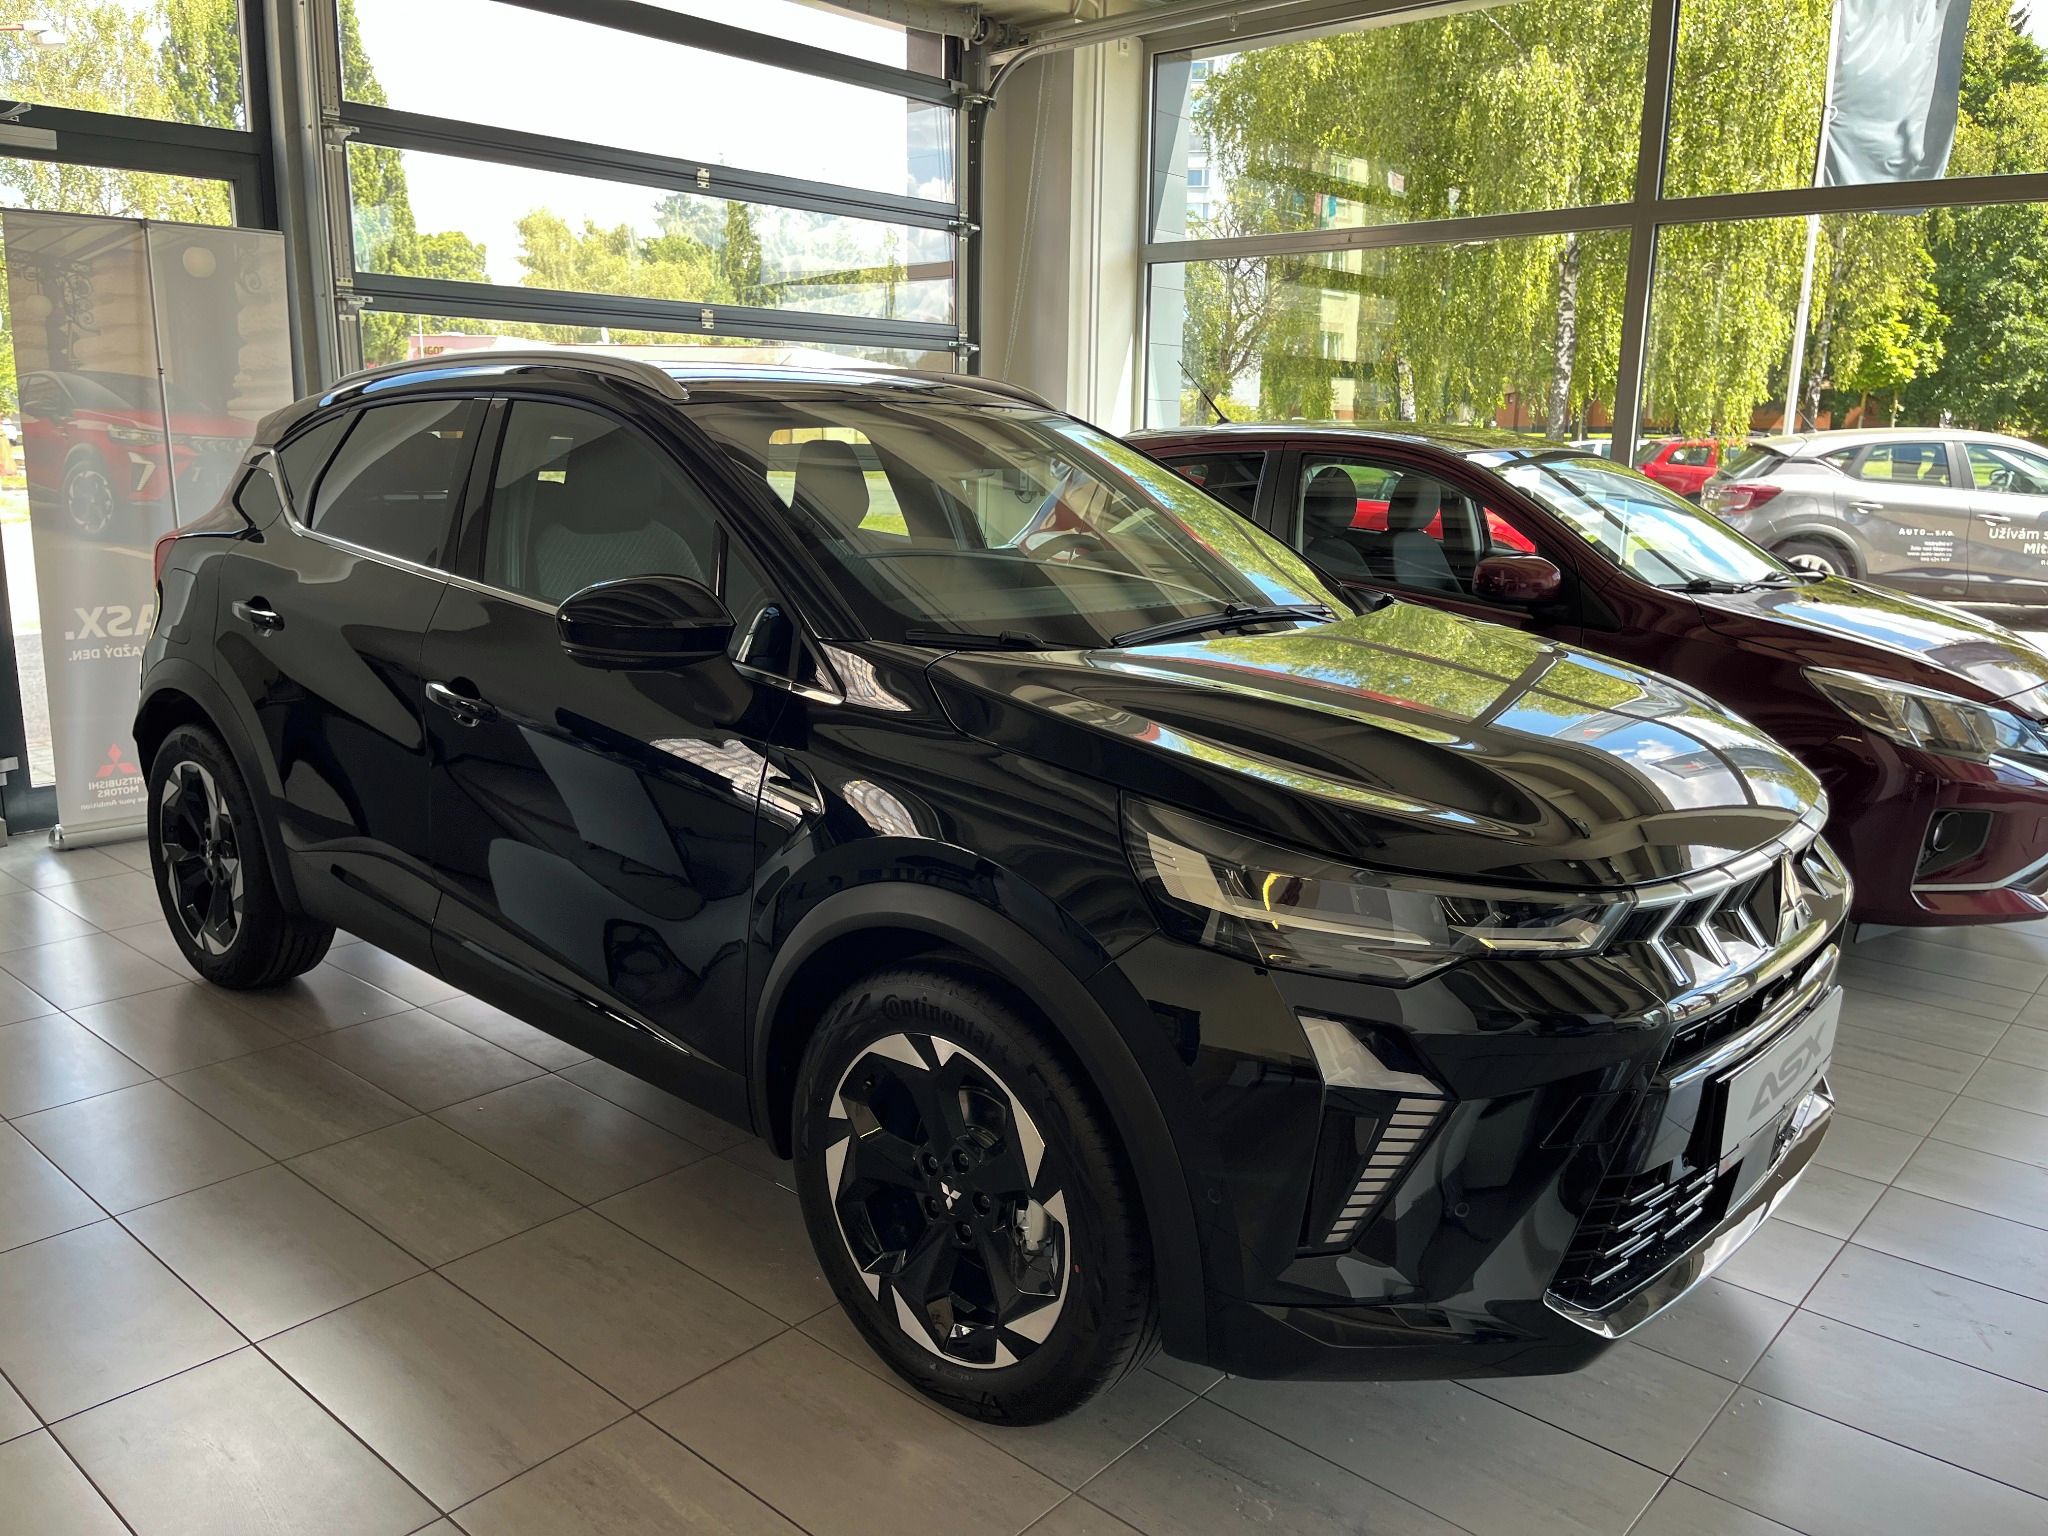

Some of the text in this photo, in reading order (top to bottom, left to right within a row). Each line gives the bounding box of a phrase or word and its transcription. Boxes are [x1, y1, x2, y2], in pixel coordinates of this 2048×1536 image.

[1898, 527, 1926, 536] AUTO
[1988, 527, 2040, 540] Užívám
[2023, 542, 2048, 554] Mit
[882, 993, 996, 1054] Continental
[1748, 1020, 1826, 1120] ASX
